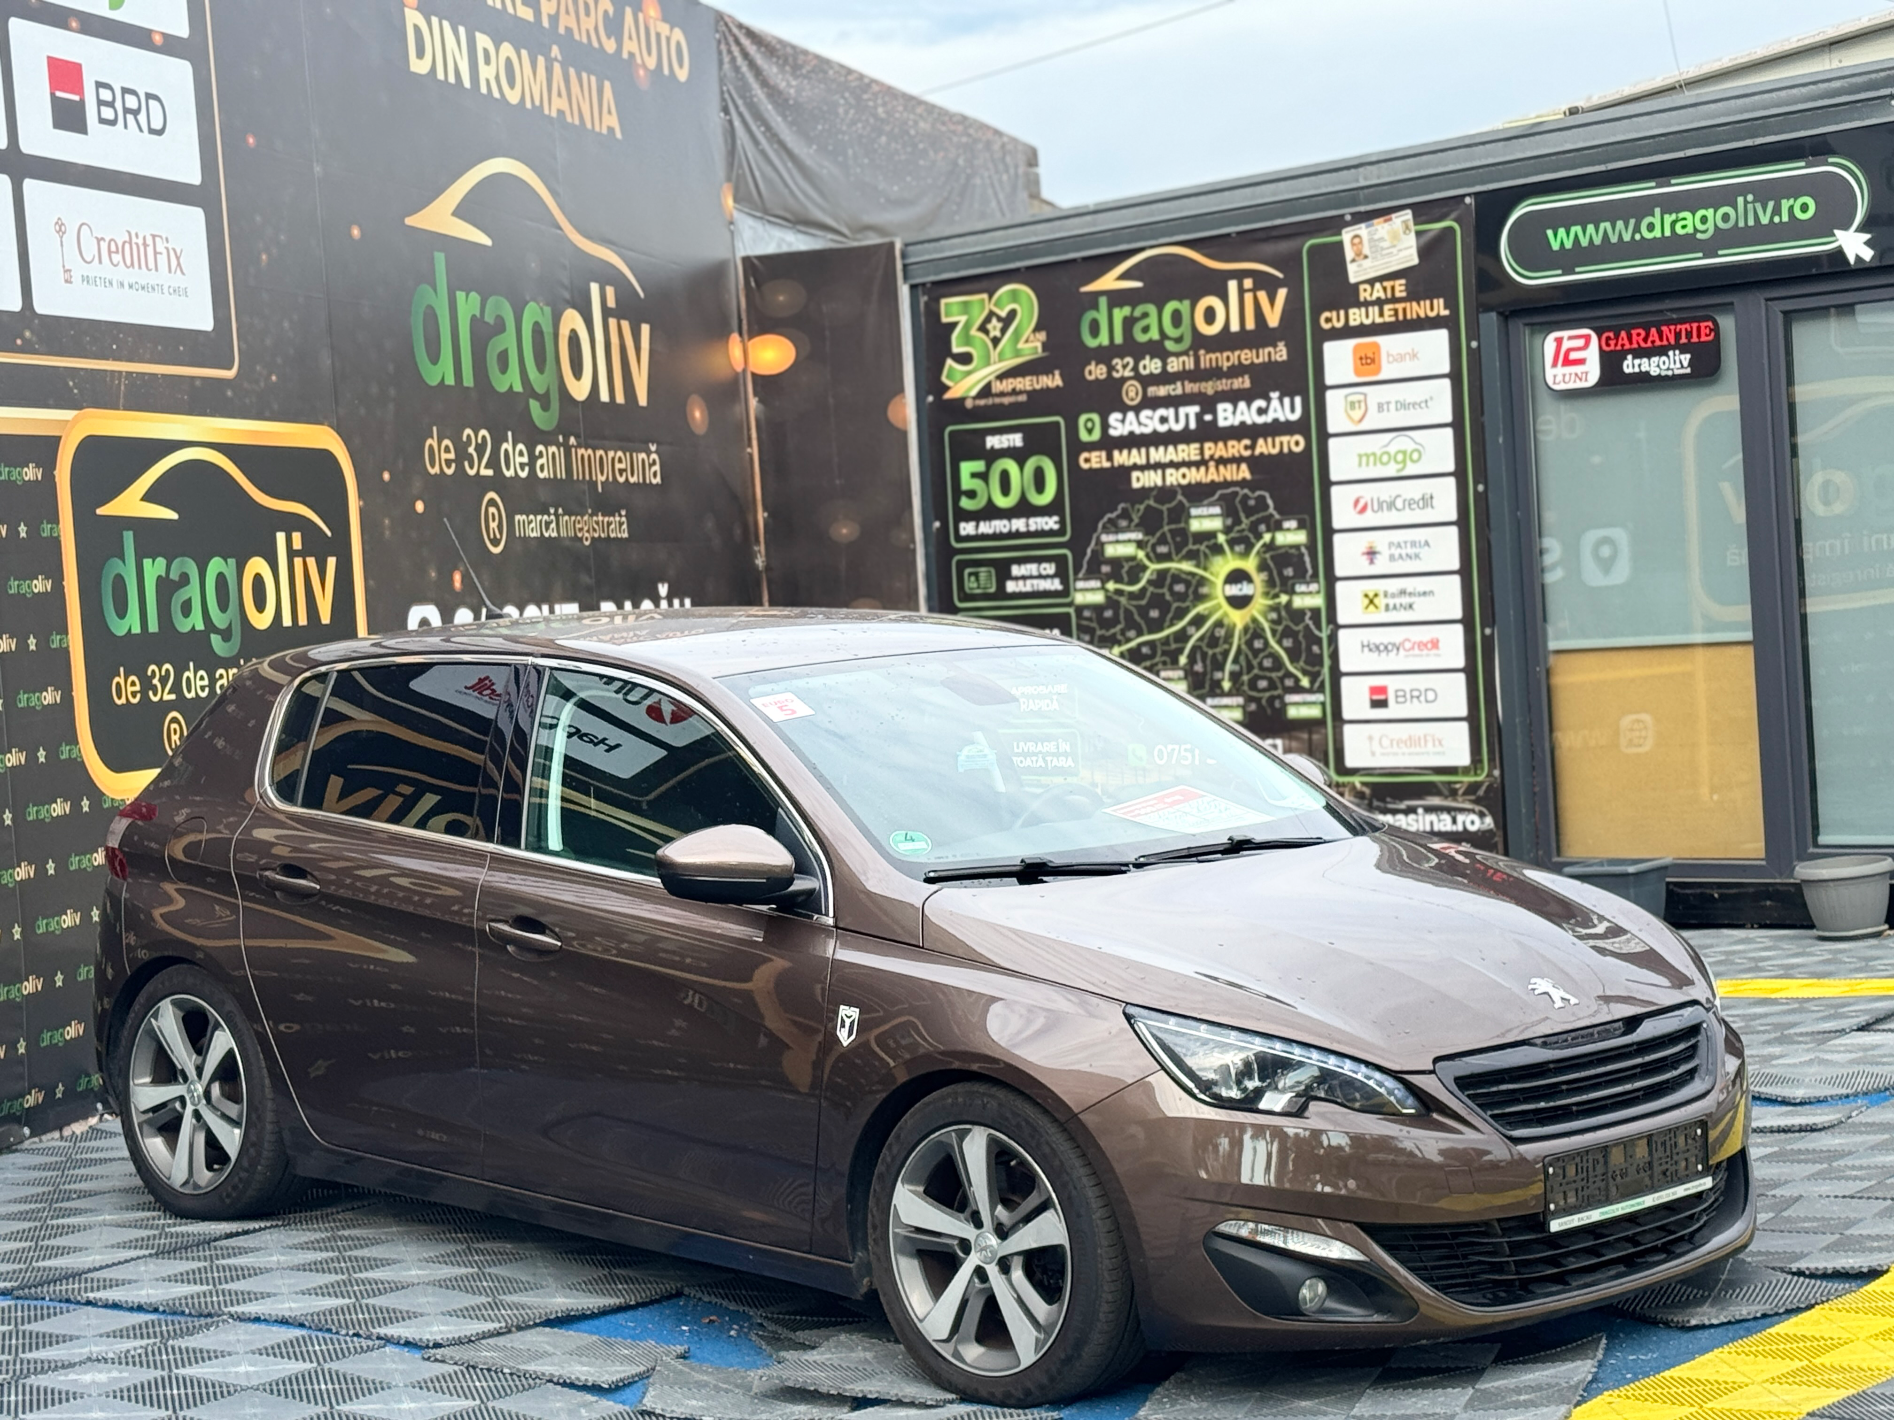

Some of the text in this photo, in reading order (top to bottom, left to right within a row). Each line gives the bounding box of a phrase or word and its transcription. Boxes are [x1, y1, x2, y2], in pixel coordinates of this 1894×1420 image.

[541, 0, 690, 83] PARC AUTO
[404, 6, 623, 140] DIN ROMÂNIA
[94, 79, 168, 137] BRD
[1546, 194, 1817, 252] www.dragoliv.ro
[76, 221, 187, 277] CreditFix
[81, 273, 189, 298] PRIETEN IN MOMENTE CHEIE
[1358, 279, 1407, 302] RATE
[1079, 278, 1289, 352] dragoliv
[1319, 298, 1450, 330] CU BULETINUL
[411, 251, 651, 431] dragoliv
[940, 283, 1043, 388] 32
[1600, 320, 1716, 352] GARANTIE
[1084, 341, 1288, 381] de 32 de ani împreună
[1358, 348, 1420, 366] tbi bank
[1551, 334, 1591, 368] 12
[1622, 350, 1692, 376] dragoliv
[1147, 382, 1183, 398] marcă
[1552, 371, 1590, 386] LUNI
[1107, 405, 1200, 437] SASCUT
[1216, 391, 1303, 427] BACĂU
[1377, 401, 1392, 413] BT
[985, 433, 1024, 450] PESTE
[1078, 434, 1305, 470] CEL MAI MARE PARC AUTO
[424, 426, 662, 493] de 32 de ani împreună
[1356, 447, 1423, 474] mogo
[958, 454, 1058, 512] 500
[1130, 461, 1251, 489] DIN ROMÂNIA
[1370, 492, 1435, 514] UniCredit
[514, 506, 558, 538] marcă
[558, 508, 629, 546] înregistrată
[959, 515, 1060, 536] DE AUTO PE STOC
[1388, 539, 1431, 551] PATRIA
[1388, 552, 1422, 563] BANK
[1011, 562, 1056, 577] RATE CU
[7, 574, 52, 598] dragoliv
[101, 530, 338, 658] dragoliv
[1005, 577, 1064, 593] BULETINUL
[1383, 588, 1435, 600] Raiffeisen
[1384, 600, 1415, 612] BANK
[1361, 637, 1441, 658] HappyCredit
[112, 666, 141, 705] de
[148, 662, 176, 702] 32
[182, 661, 209, 700] de
[17, 686, 61, 710] dragoliv
[1020, 695, 1060, 713] RAPIDĂ
[1395, 688, 1438, 704] BRD
[777, 704, 798, 716] 5
[1013, 741, 1056, 754] LIVRARE
[1378, 733, 1445, 750] CreditFix
[1011, 755, 1044, 768] TOATĂ
[26, 797, 71, 822] dragoliv
[68, 847, 107, 872] dragoli
[35, 908, 81, 935] dragoliv
[40, 1019, 86, 1048] dragoliv
